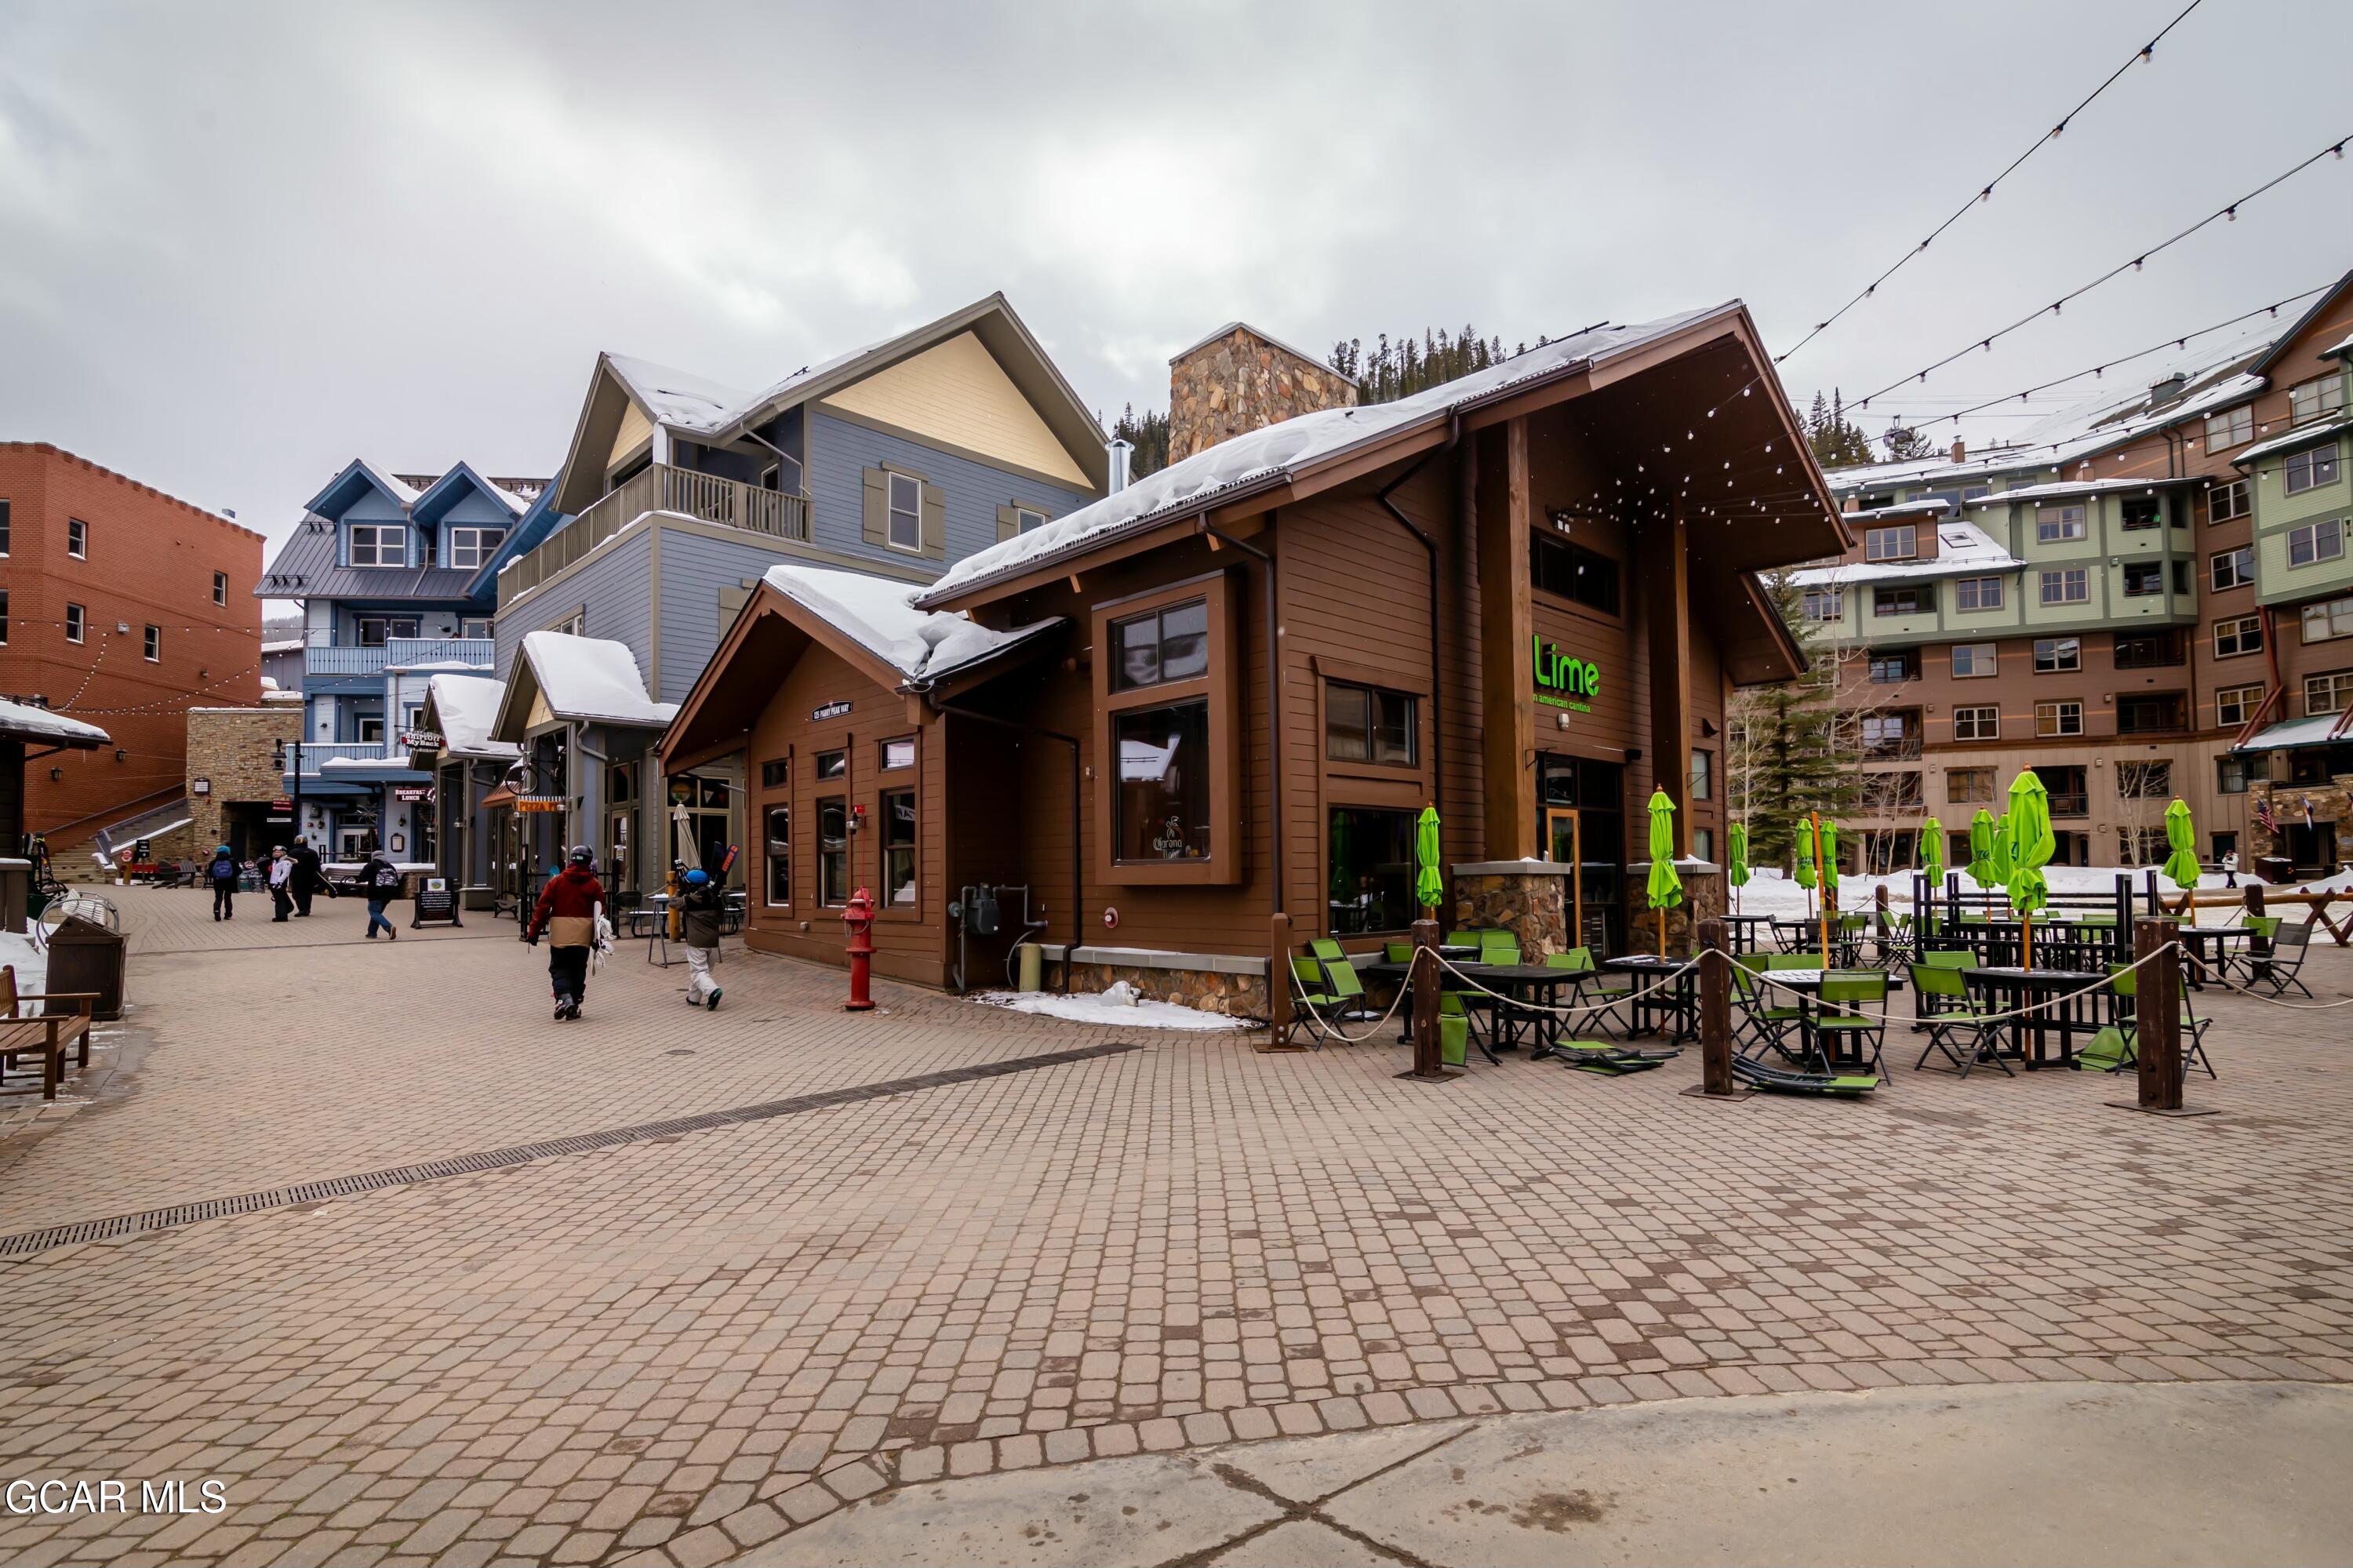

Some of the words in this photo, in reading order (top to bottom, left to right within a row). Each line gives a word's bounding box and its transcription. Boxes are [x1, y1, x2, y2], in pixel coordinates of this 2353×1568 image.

[1533, 635, 1599, 697] Lime
[831, 706, 841, 715] PEAK
[840, 704, 849, 713] WAY
[1539, 695, 1568, 708] american
[1569, 702, 1591, 713] cantina
[519, 801, 546, 812] PIZZA
[1153, 837, 1183, 851] Corona
